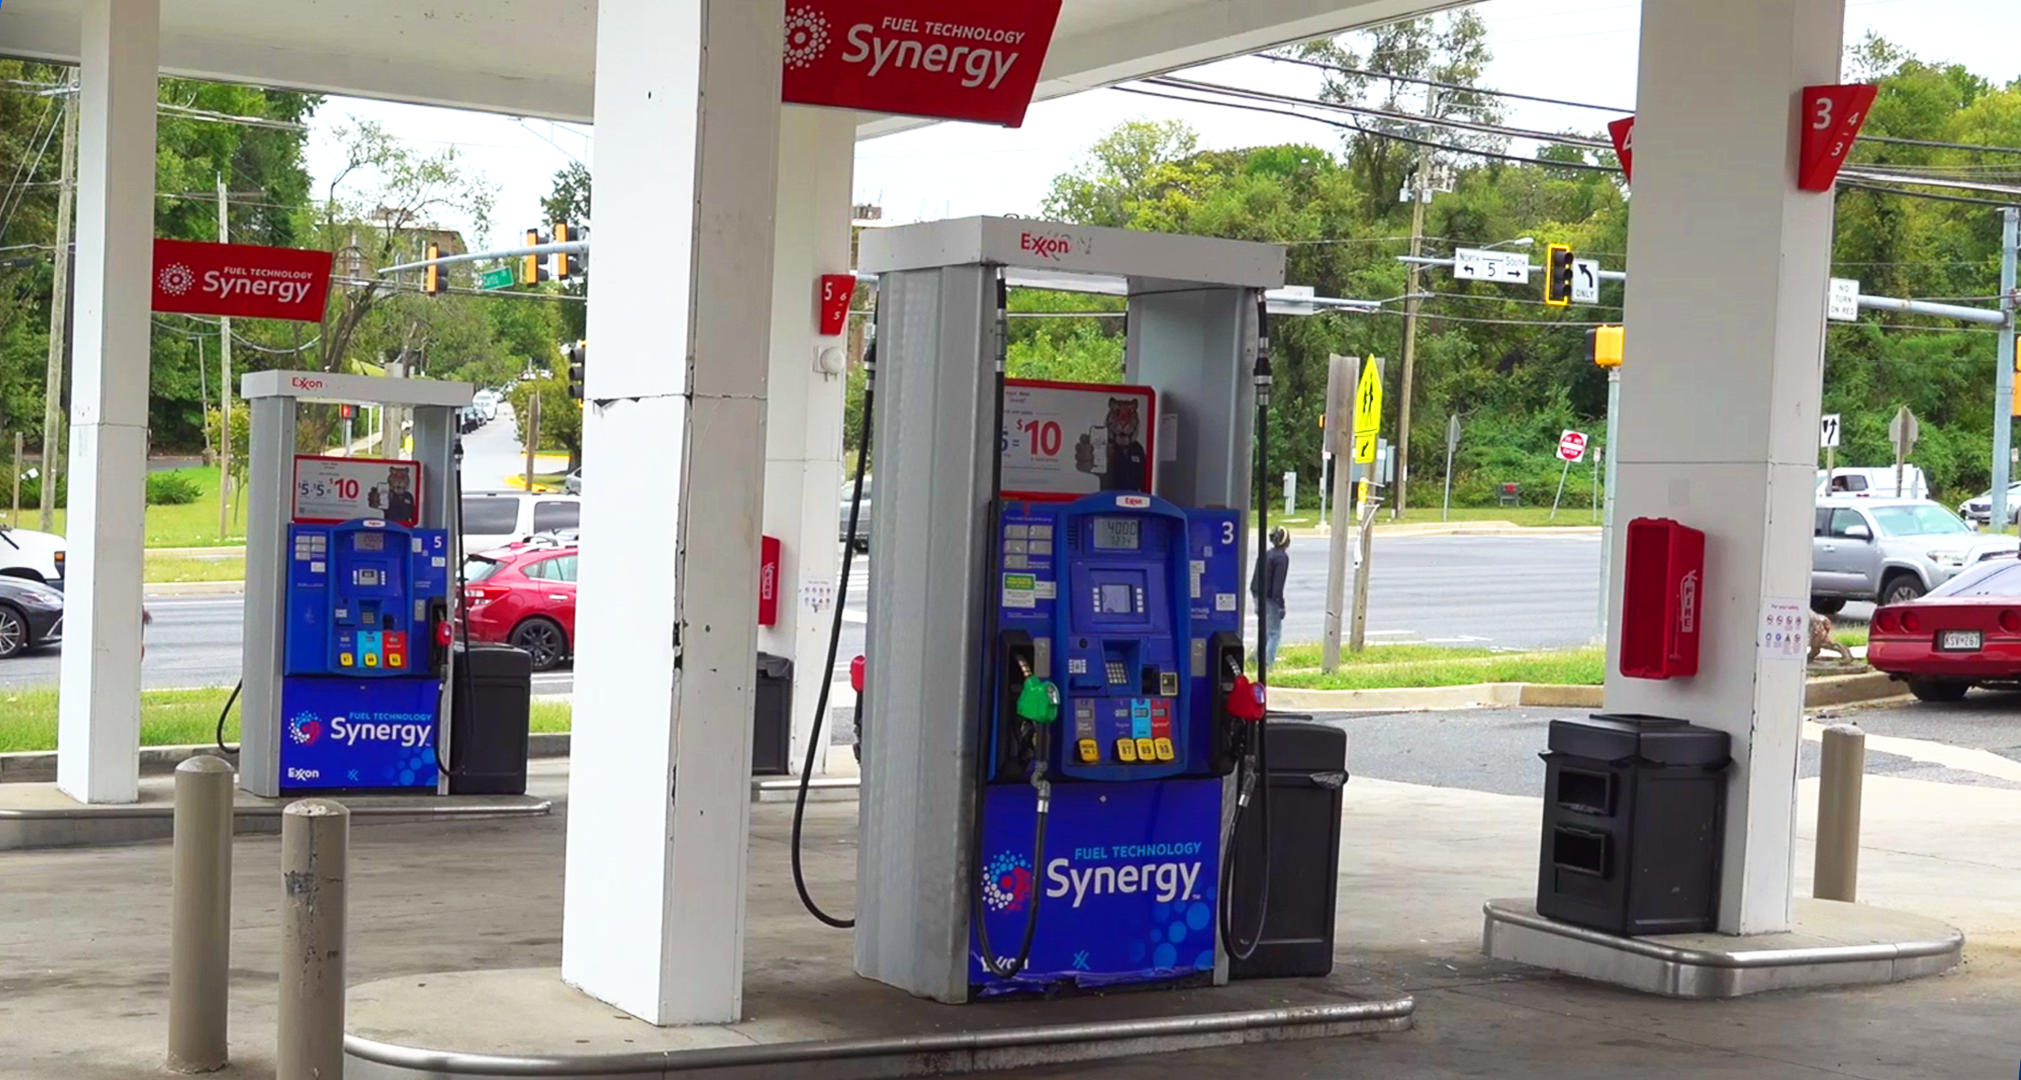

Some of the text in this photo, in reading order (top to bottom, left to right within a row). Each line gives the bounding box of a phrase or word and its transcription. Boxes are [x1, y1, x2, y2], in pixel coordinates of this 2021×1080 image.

[882, 16, 1025, 45] FUEL TECHNOLOGY
[841, 23, 1018, 90] Synergy
[1812, 97, 1833, 130] 3
[1847, 111, 1859, 126] 4
[1831, 141, 1843, 157] 3
[1020, 233, 1069, 258] Exxon
[223, 266, 313, 279] FUEL TECHNOLOGY
[1487, 262, 1495, 277] 5
[202, 270, 311, 303] Synergy
[824, 282, 833, 300] 5
[1576, 289, 1595, 298] ONLY
[1839, 284, 1849, 293] NO
[840, 292, 847, 301] 6
[1835, 294, 1851, 303] TURN
[833, 311, 840, 320] 5
[292, 377, 323, 391] Exxon
[329, 478, 359, 499] $10
[1221, 521, 1235, 545] 3
[434, 536, 442, 549] 5
[1684, 586, 1693, 627] FIRE
[349, 711, 432, 722] FUEL TECHNOLOGY
[330, 716, 432, 747] Synergy
[287, 767, 320, 782] Exxon
[1074, 841, 1202, 860] FUEL TECHNOLOGY
[1046, 858, 1202, 908] Synergy
